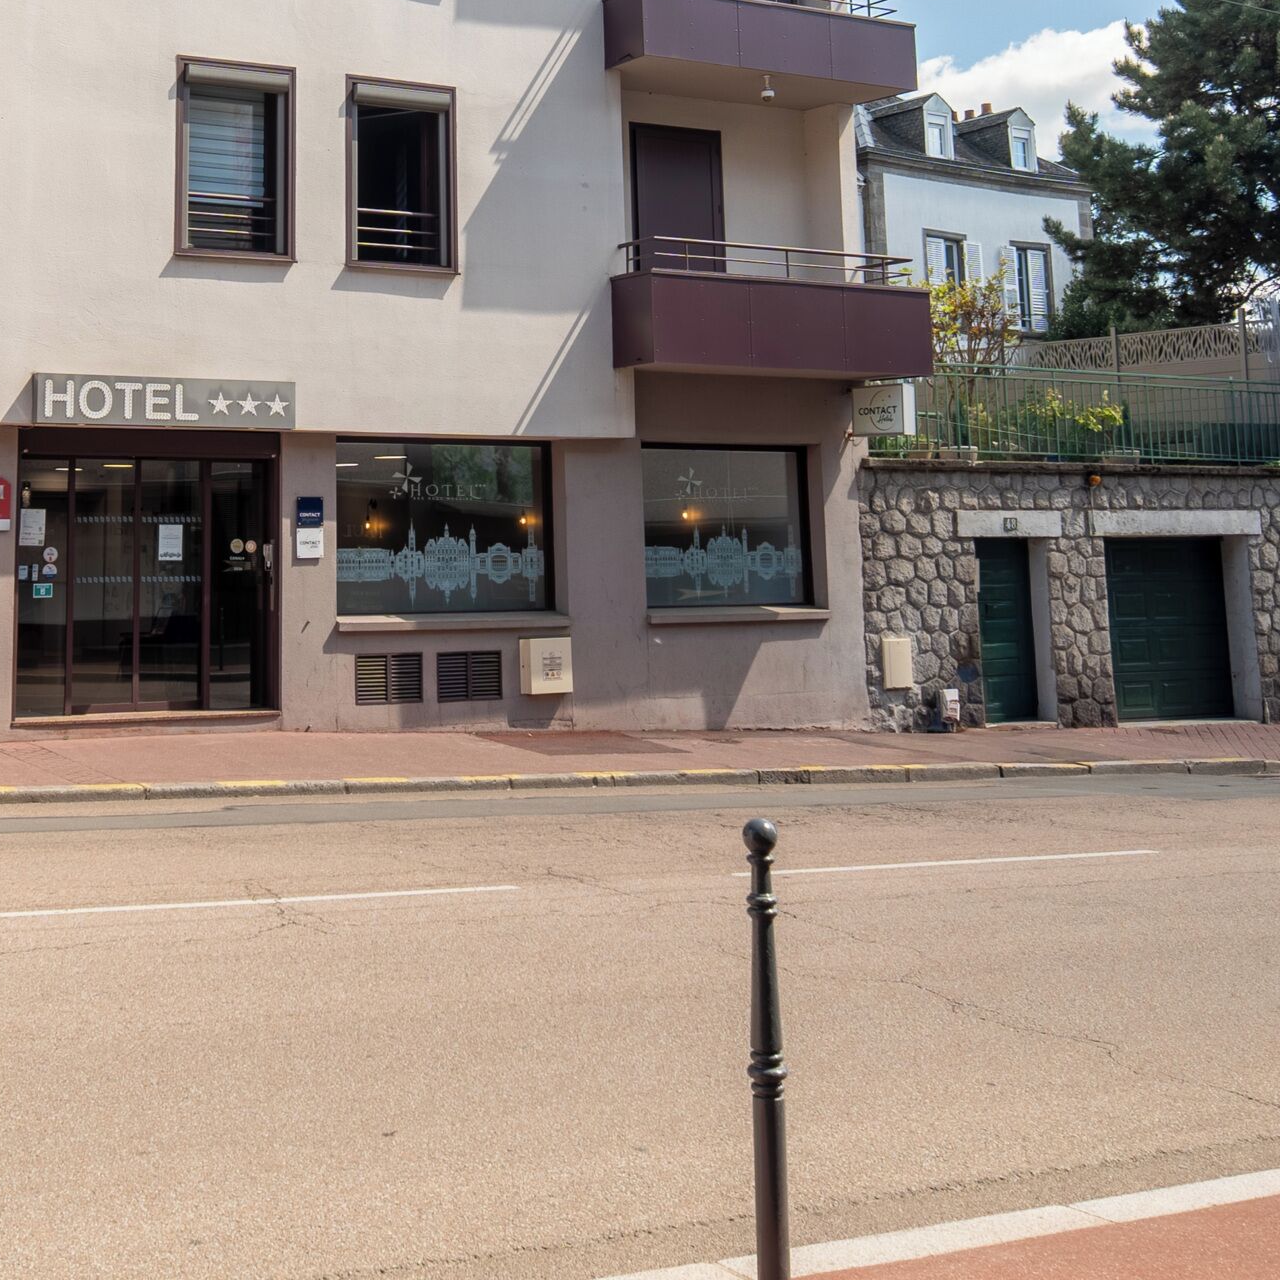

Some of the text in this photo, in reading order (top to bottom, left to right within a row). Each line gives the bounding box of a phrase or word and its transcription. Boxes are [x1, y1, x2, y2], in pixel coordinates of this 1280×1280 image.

[44, 379, 200, 421] HOTEL
[858, 406, 897, 416] CONTACT
[410, 483, 481, 499] HOTEL
[1004, 518, 1017, 530] 48
